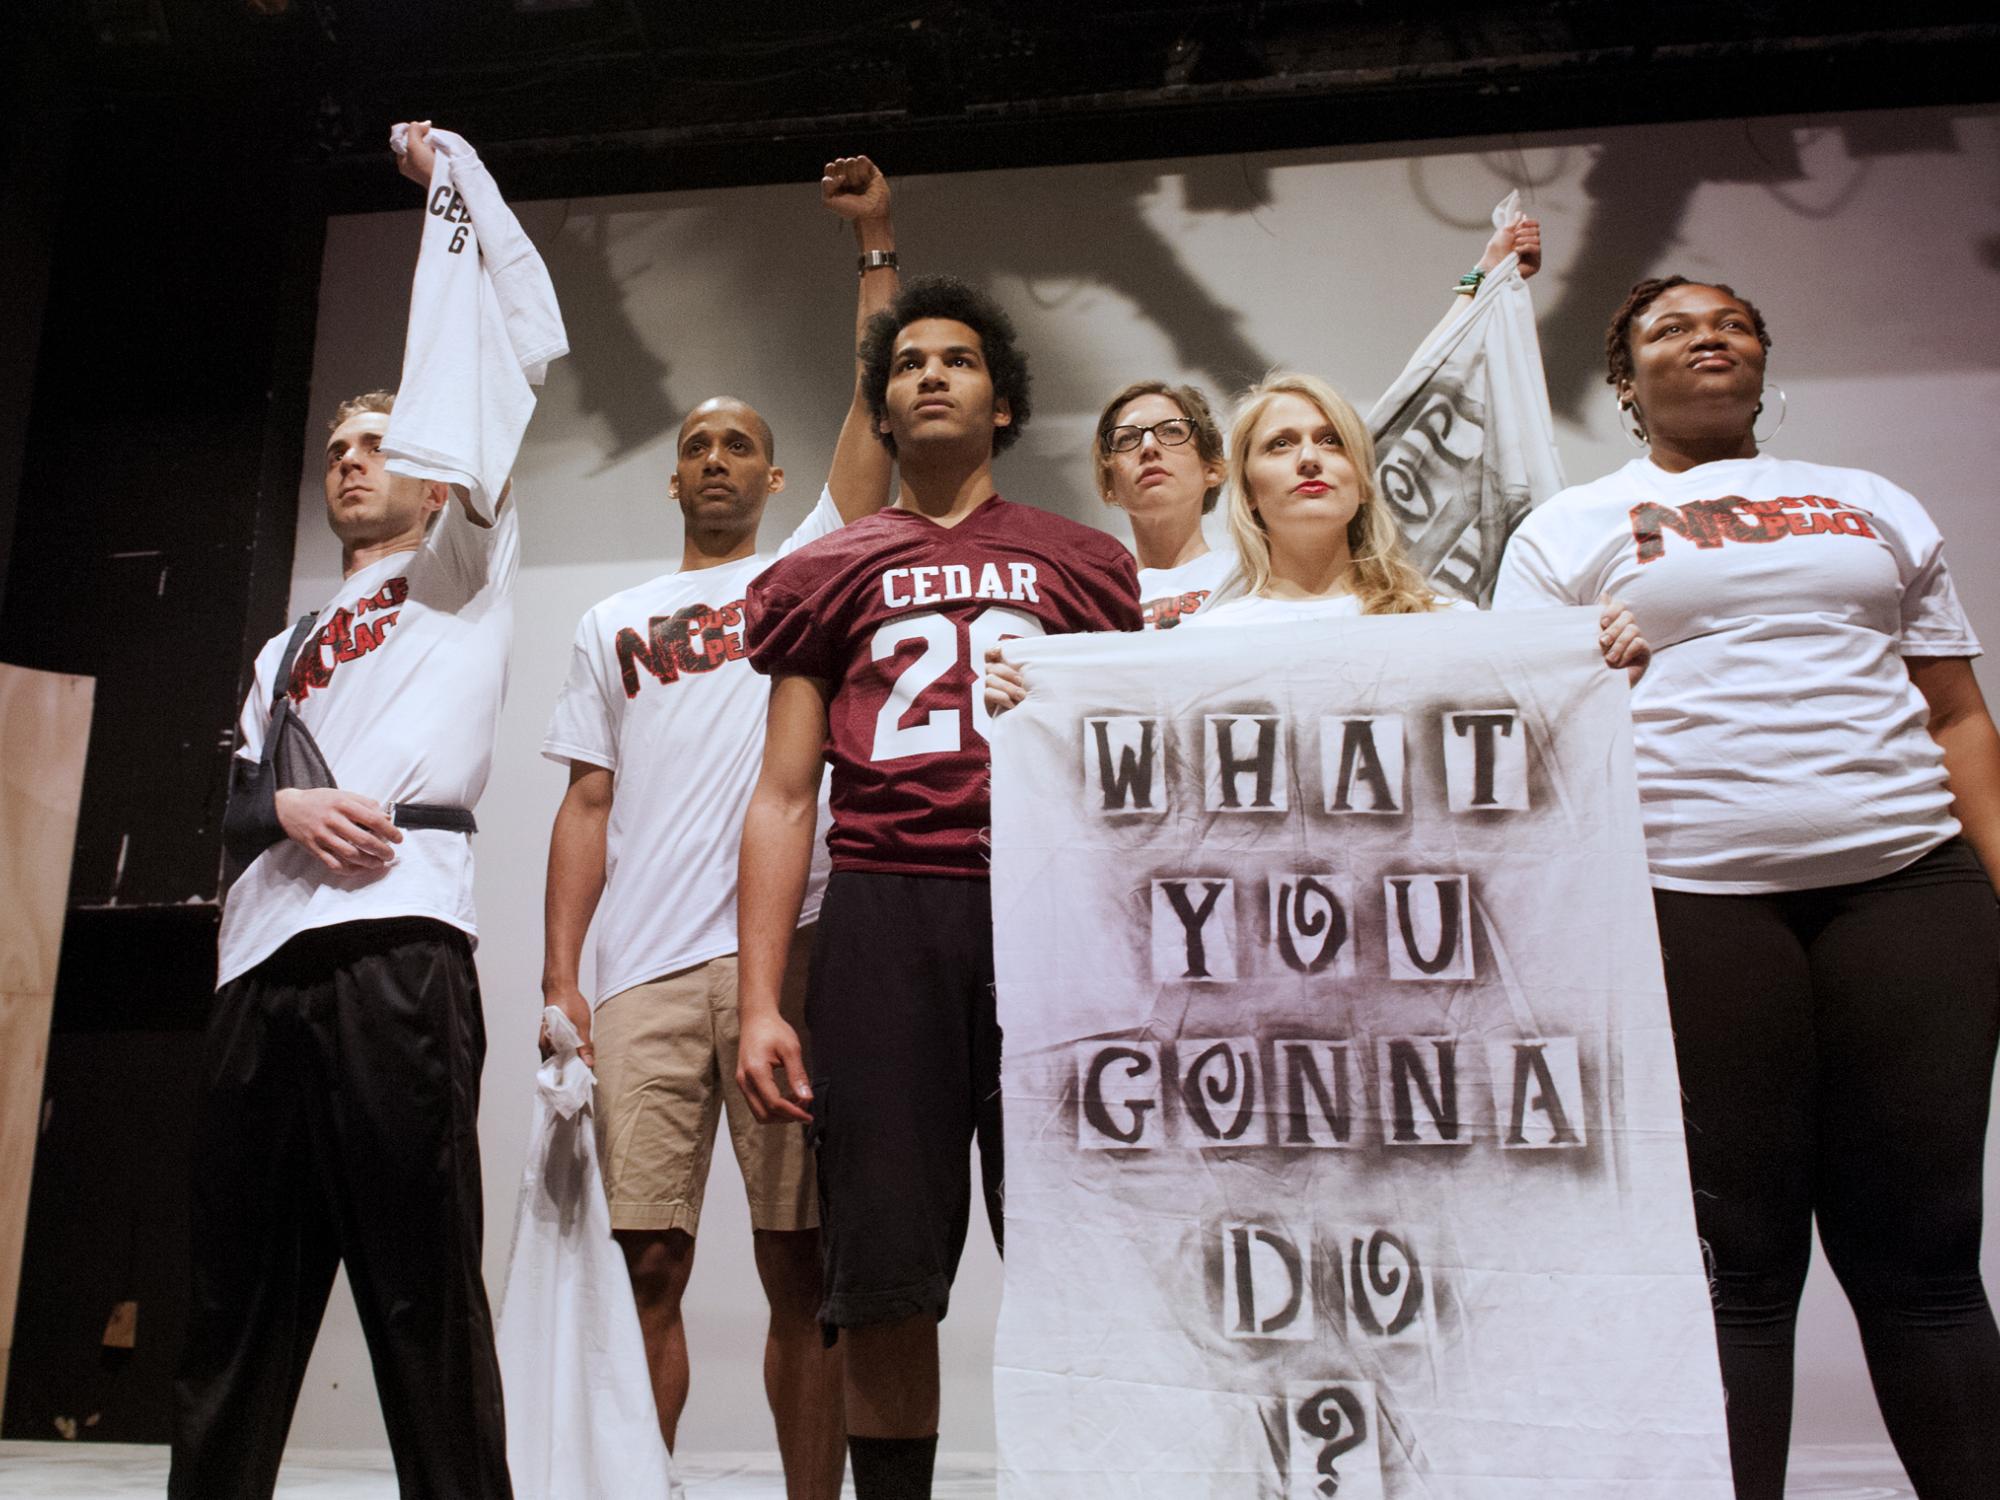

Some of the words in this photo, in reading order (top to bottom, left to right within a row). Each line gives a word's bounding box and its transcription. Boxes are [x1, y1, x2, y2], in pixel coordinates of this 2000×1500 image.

[882, 562, 1040, 608] CEDAR
[1091, 714, 1514, 811] WHAT
[1160, 877, 1461, 978] YOU
[1083, 1041, 1581, 1145] GONNA
[1228, 1229, 1425, 1336] DO
[1297, 1386, 1368, 1498] ?
